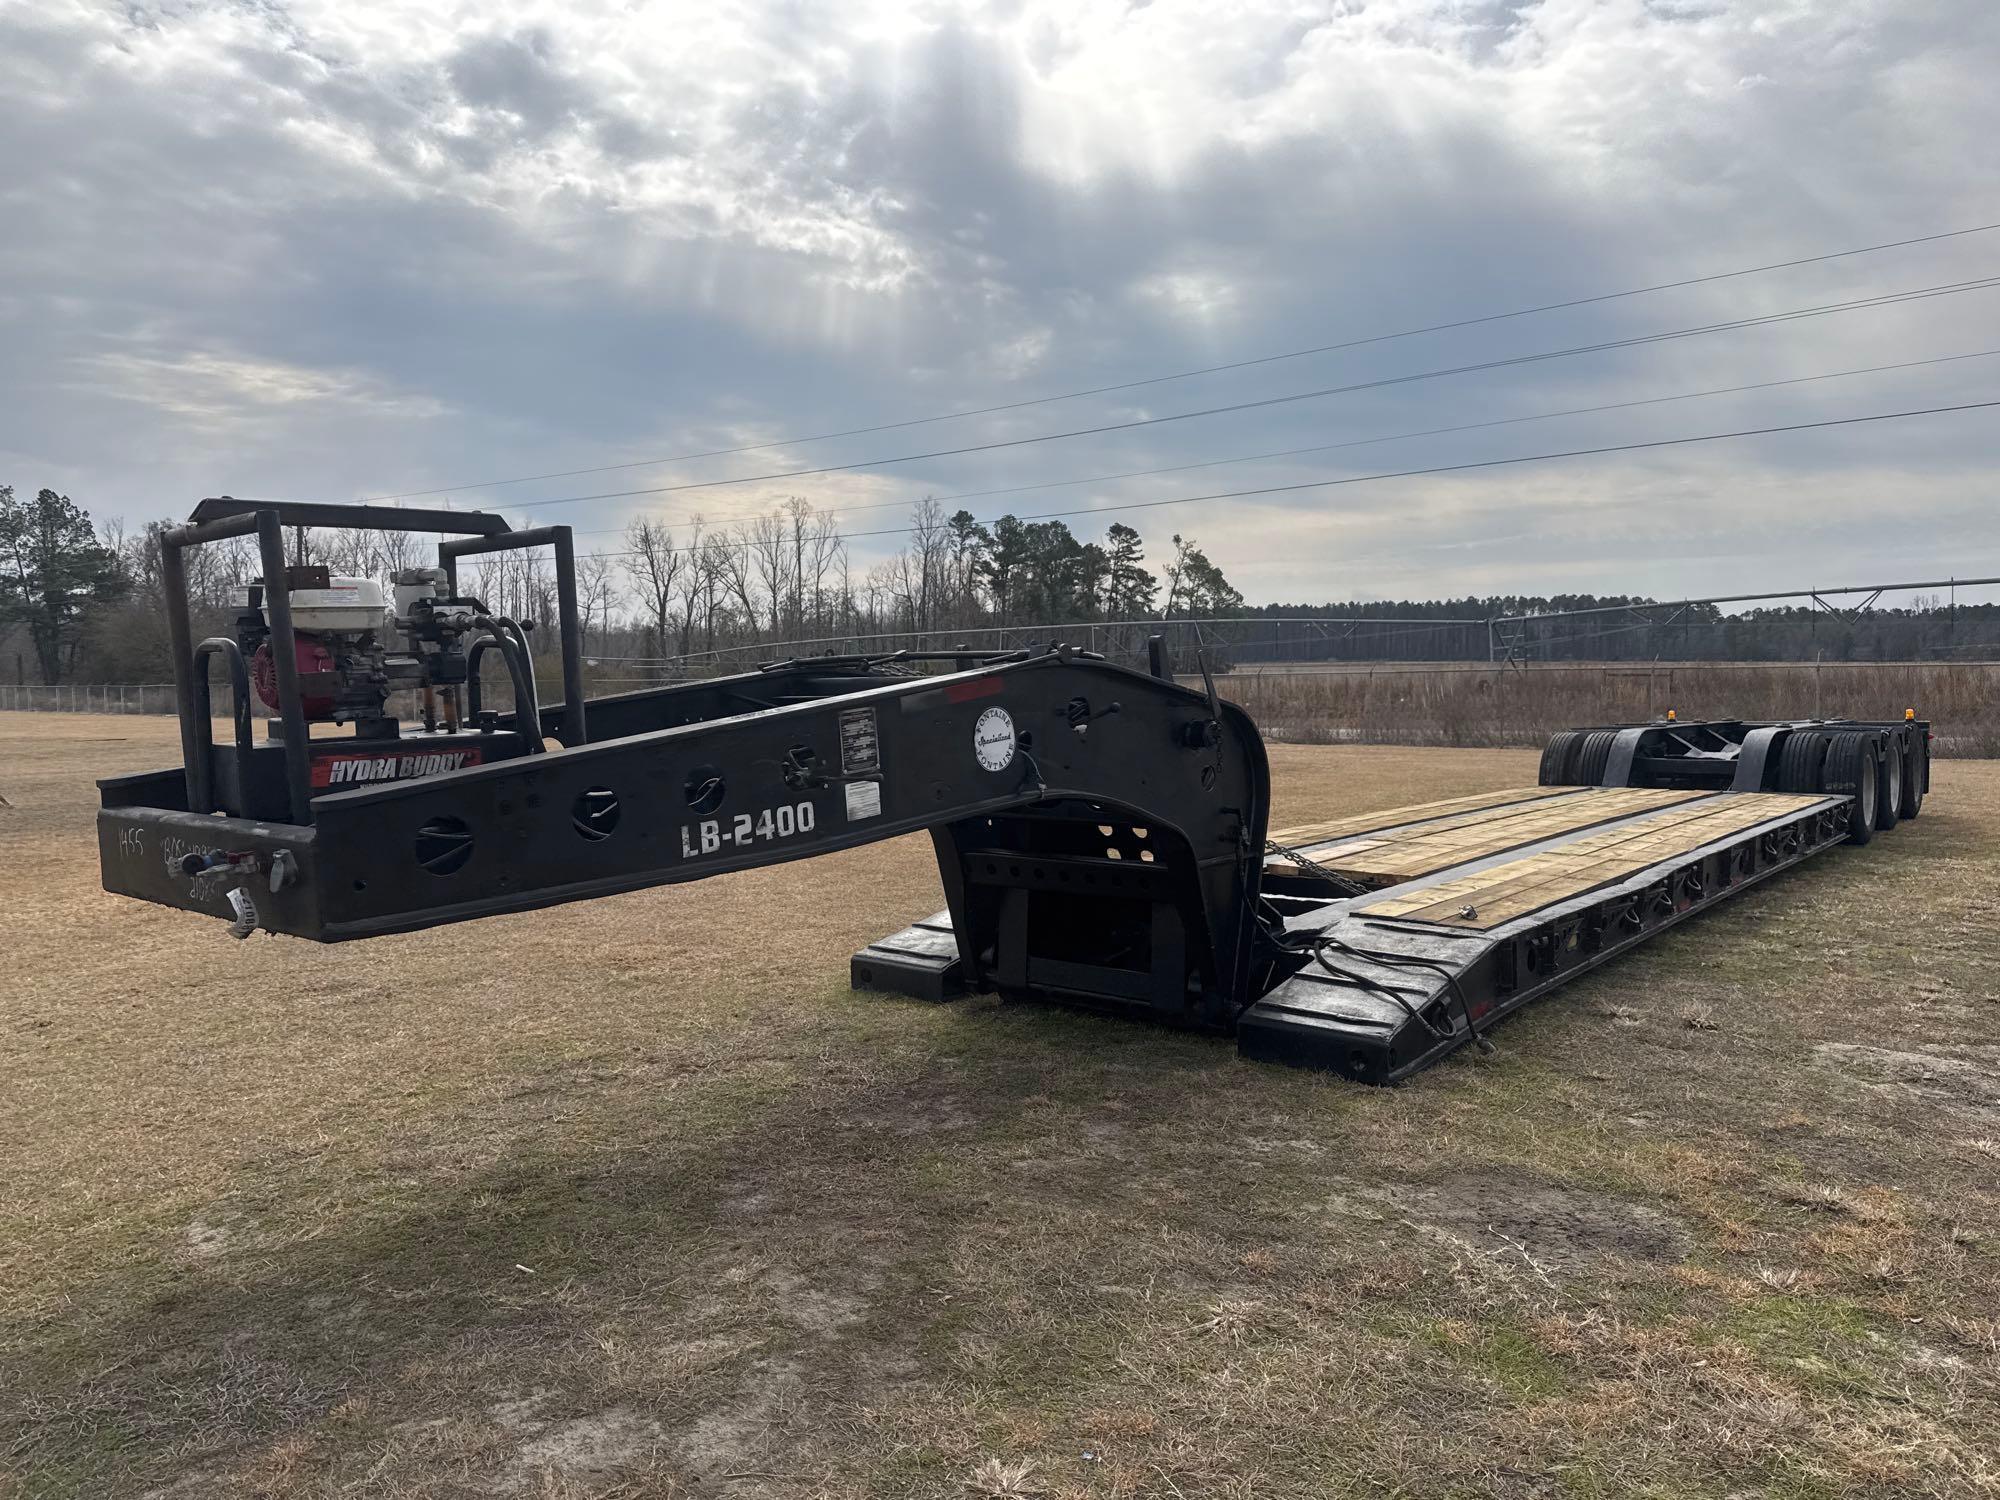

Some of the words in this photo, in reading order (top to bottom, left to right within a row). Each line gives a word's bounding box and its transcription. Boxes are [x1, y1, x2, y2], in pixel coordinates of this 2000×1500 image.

[976, 708, 1011, 733] FONTAINE
[329, 757, 397, 784] HYDRA
[399, 751, 466, 778] BUDDY
[976, 743, 1014, 770] FONTAINE
[680, 801, 816, 859] LB-2400
